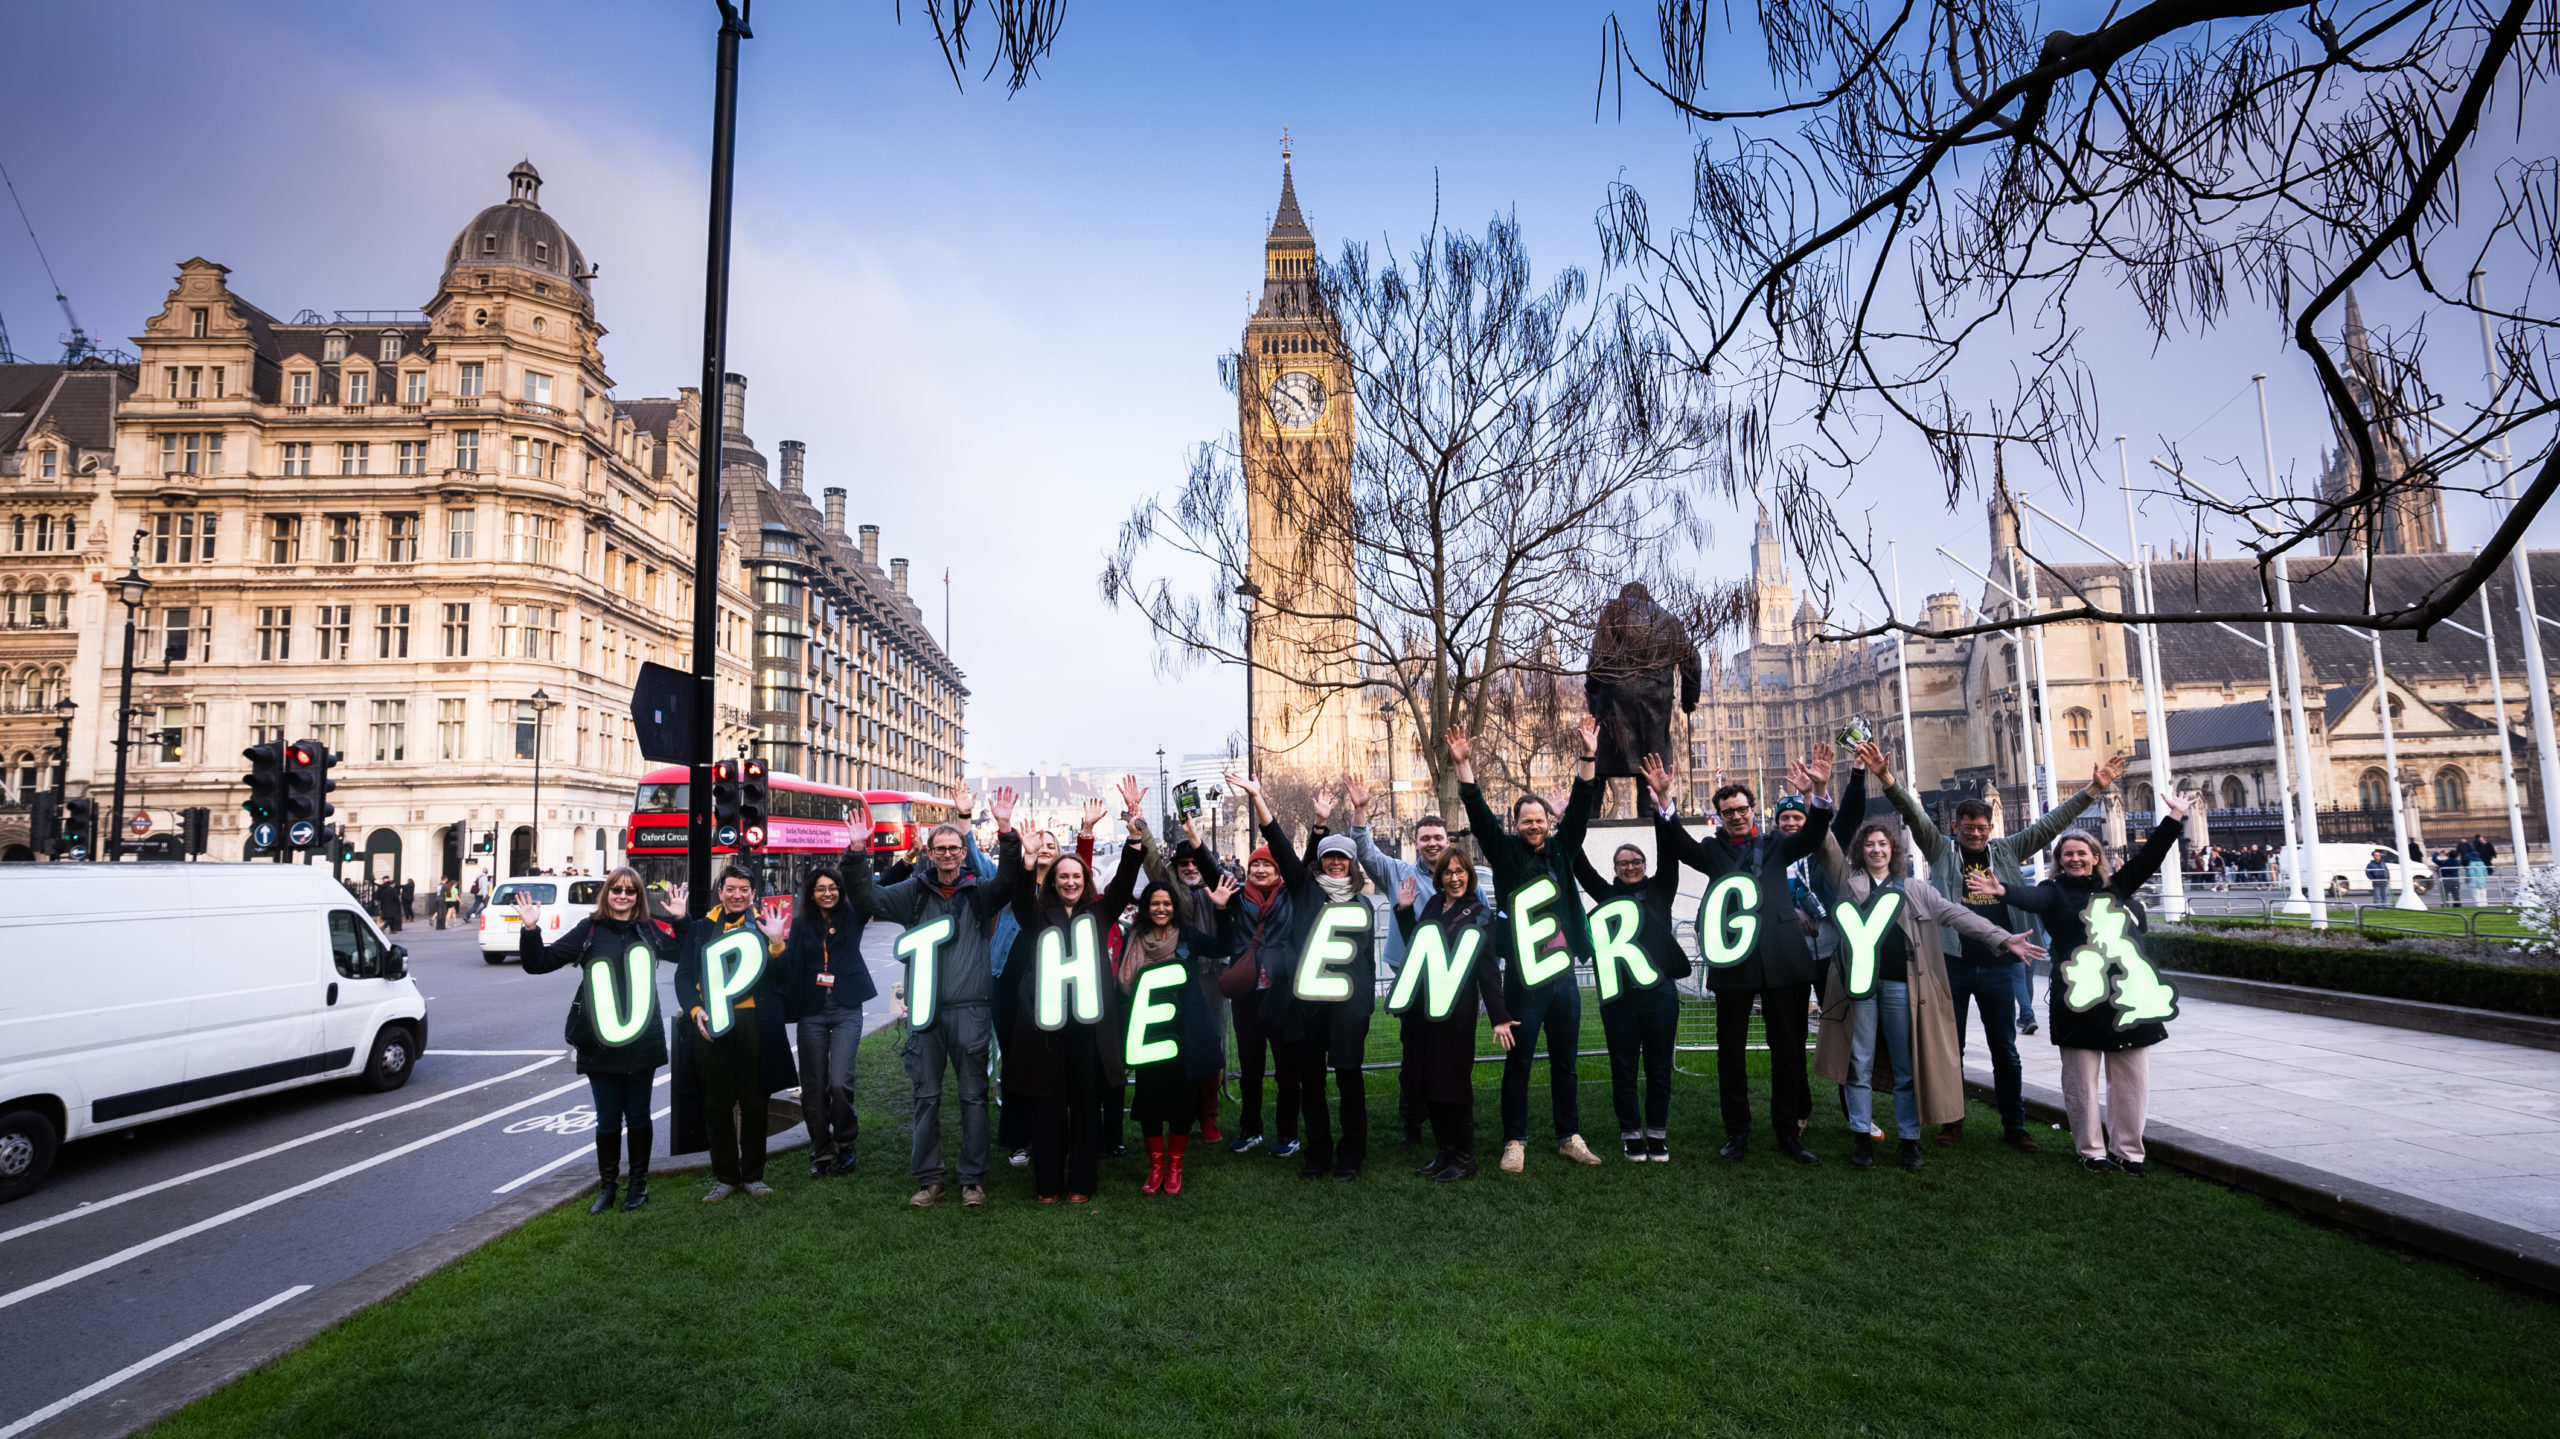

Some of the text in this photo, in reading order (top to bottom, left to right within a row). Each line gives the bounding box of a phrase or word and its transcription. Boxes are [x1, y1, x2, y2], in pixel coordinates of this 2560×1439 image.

[641, 833, 689, 841] Oxford Circus
[885, 834, 895, 844] 12
[590, 875, 1901, 1066] UP THE ENERGY
